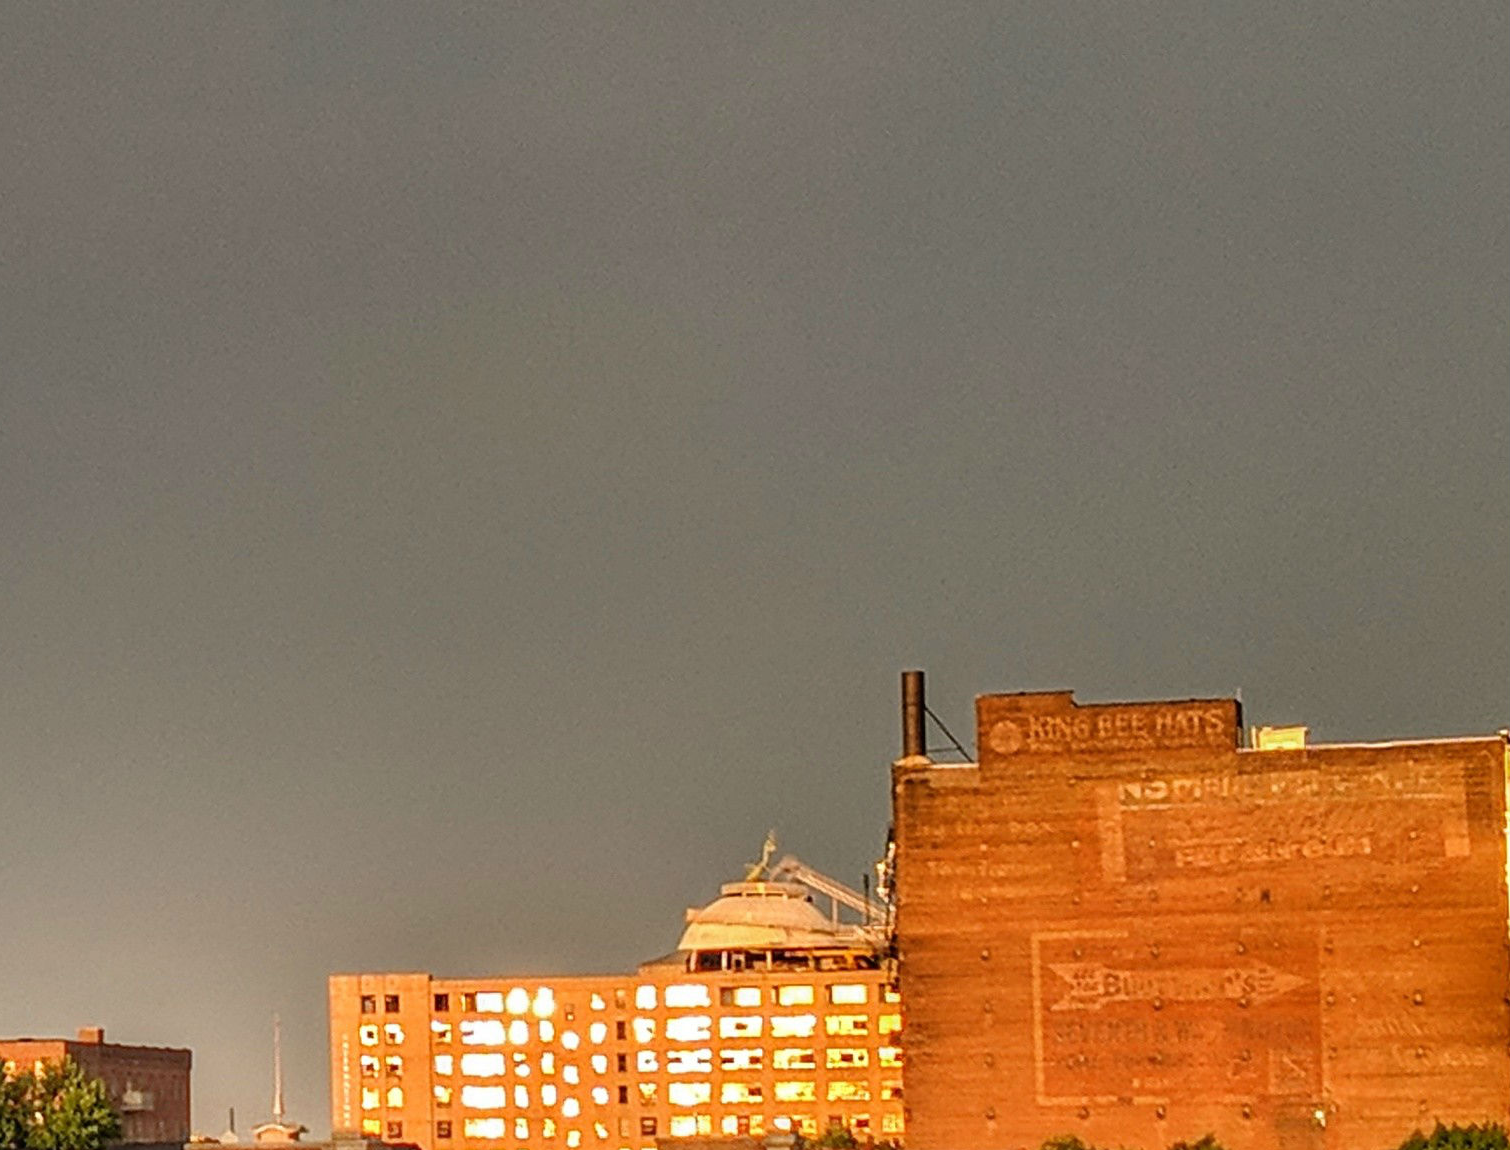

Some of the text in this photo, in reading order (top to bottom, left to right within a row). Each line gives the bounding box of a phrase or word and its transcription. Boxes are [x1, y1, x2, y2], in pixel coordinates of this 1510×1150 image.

[1027, 707, 1226, 740] KING BEE HATS
